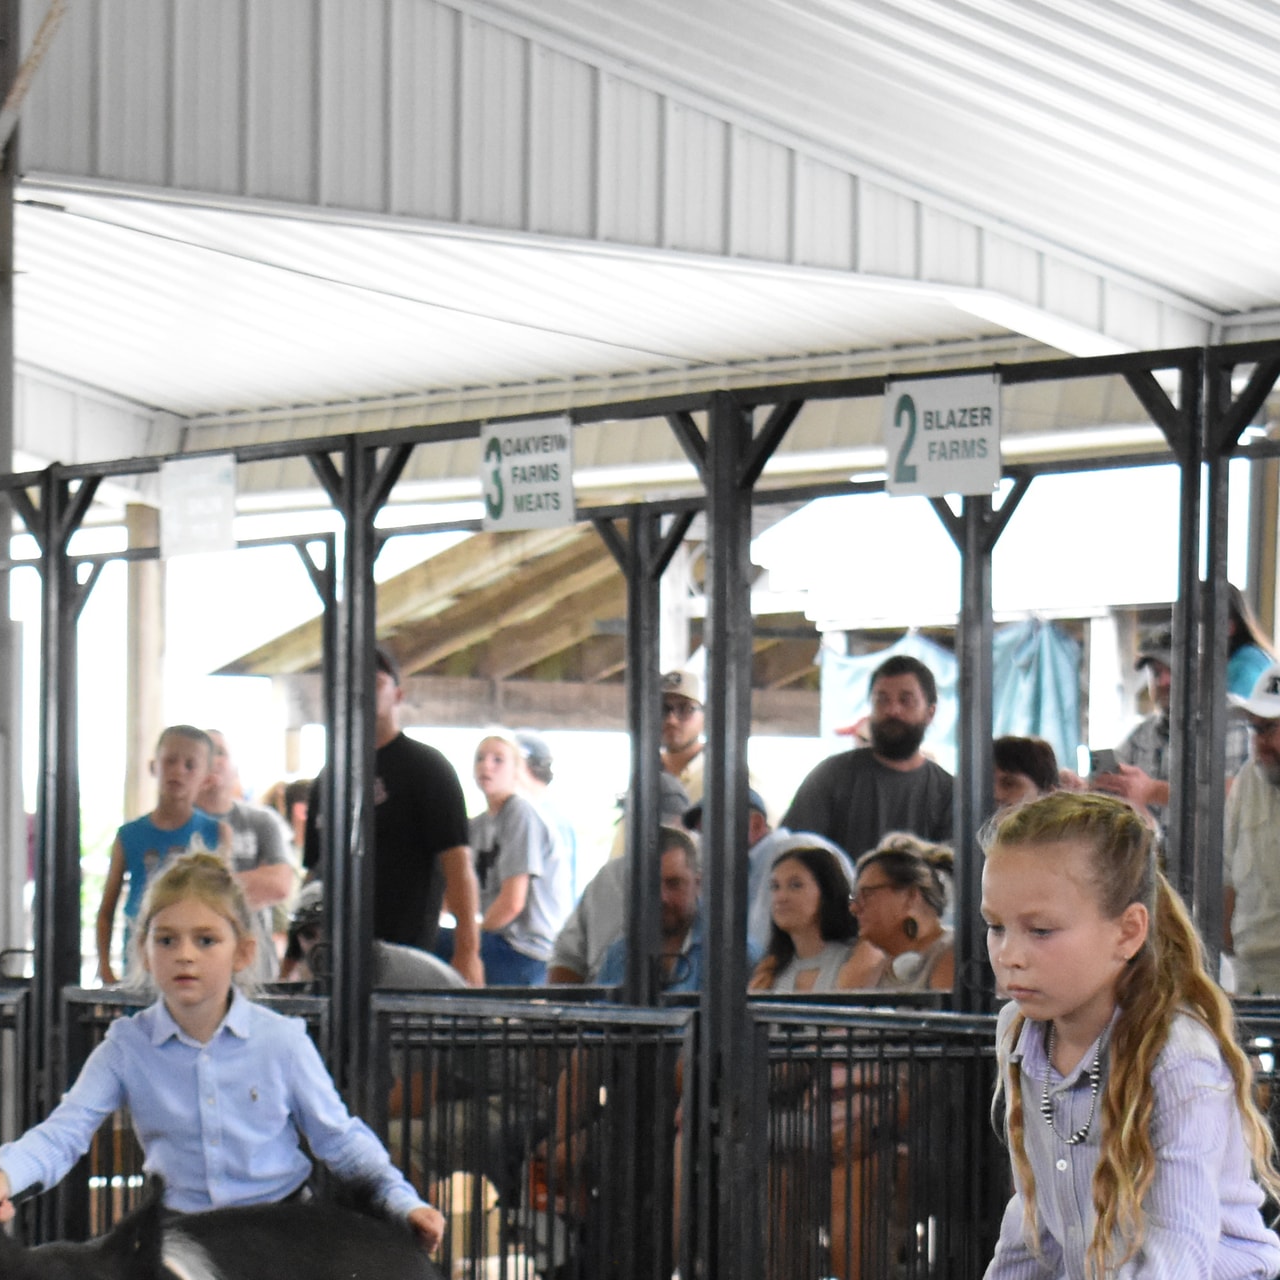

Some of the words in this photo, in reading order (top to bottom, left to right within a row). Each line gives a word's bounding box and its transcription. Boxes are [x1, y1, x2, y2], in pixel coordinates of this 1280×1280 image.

[923, 406, 992, 431] BLAZER
[894, 393, 917, 484] 2
[928, 438, 988, 461] FARMS
[485, 436, 504, 521] 3
[511, 463, 560, 484] FARMS
[513, 492, 561, 513] MEATS
